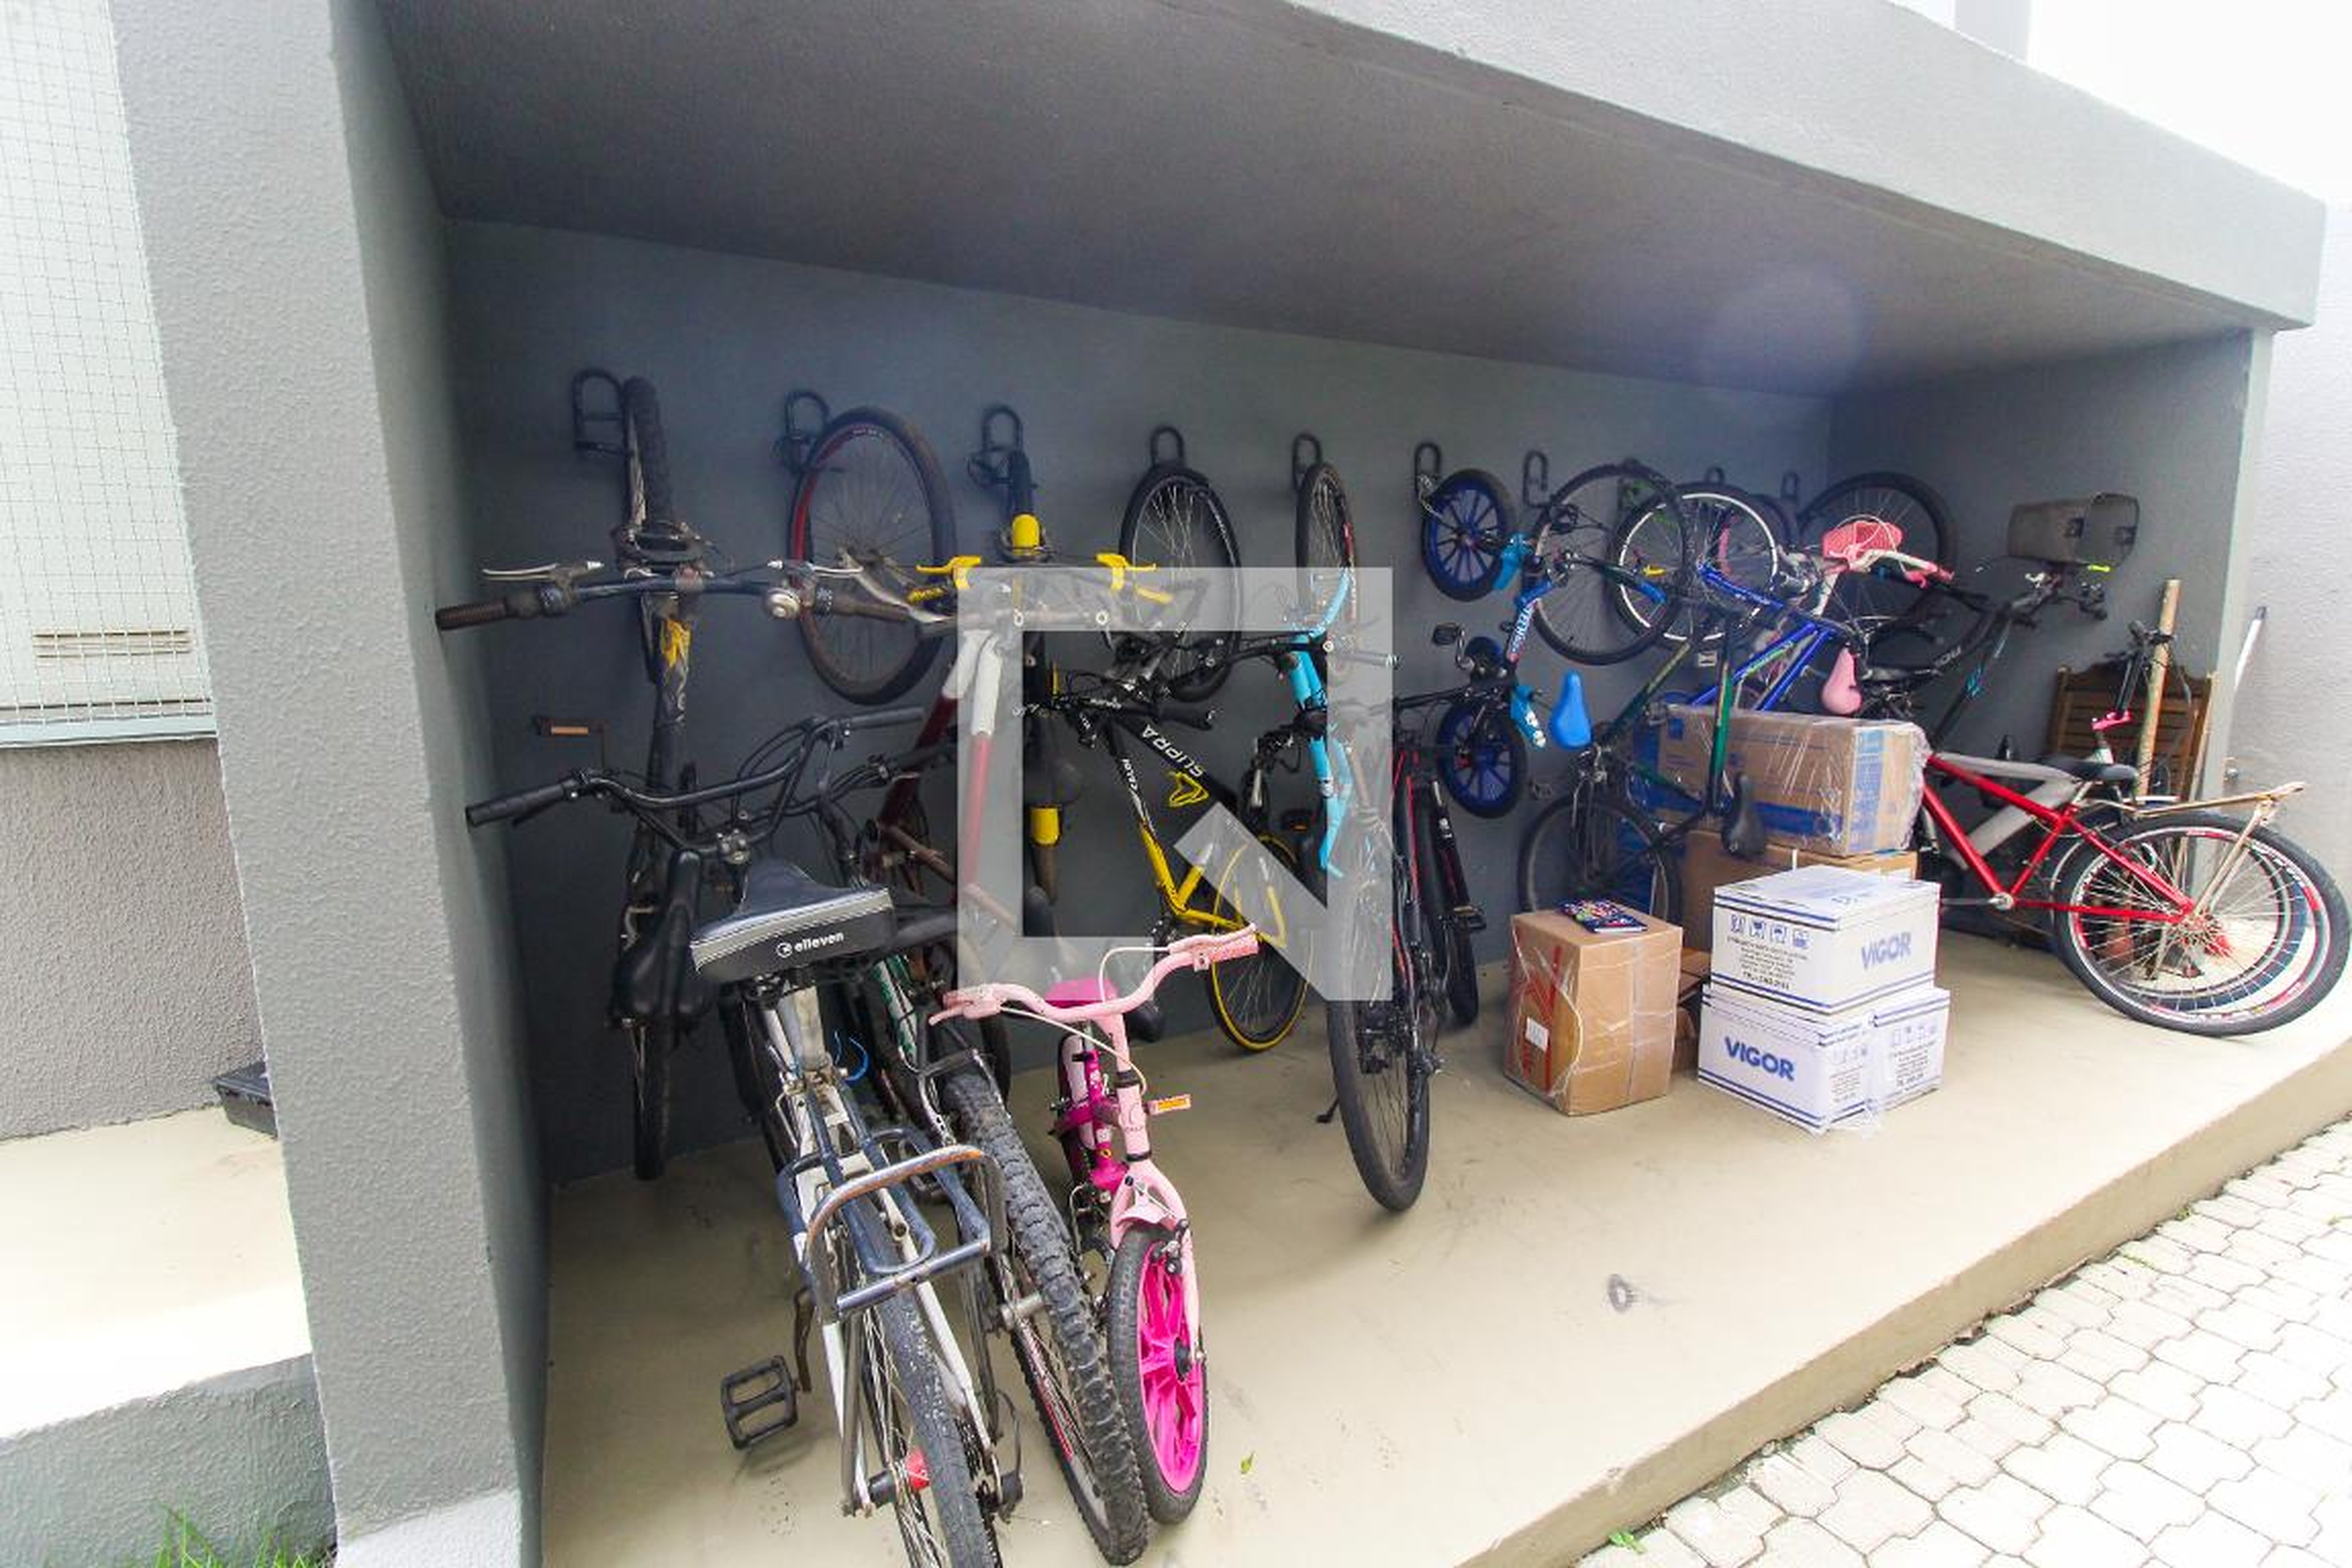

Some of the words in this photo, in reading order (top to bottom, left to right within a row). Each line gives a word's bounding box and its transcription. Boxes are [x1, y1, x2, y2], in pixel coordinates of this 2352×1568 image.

[1142, 725, 1203, 777] SUPRA
[794, 932, 844, 952] elleven
[1861, 932, 1912, 970] VIGOR
[1724, 1036, 1795, 1082] VIGOR
